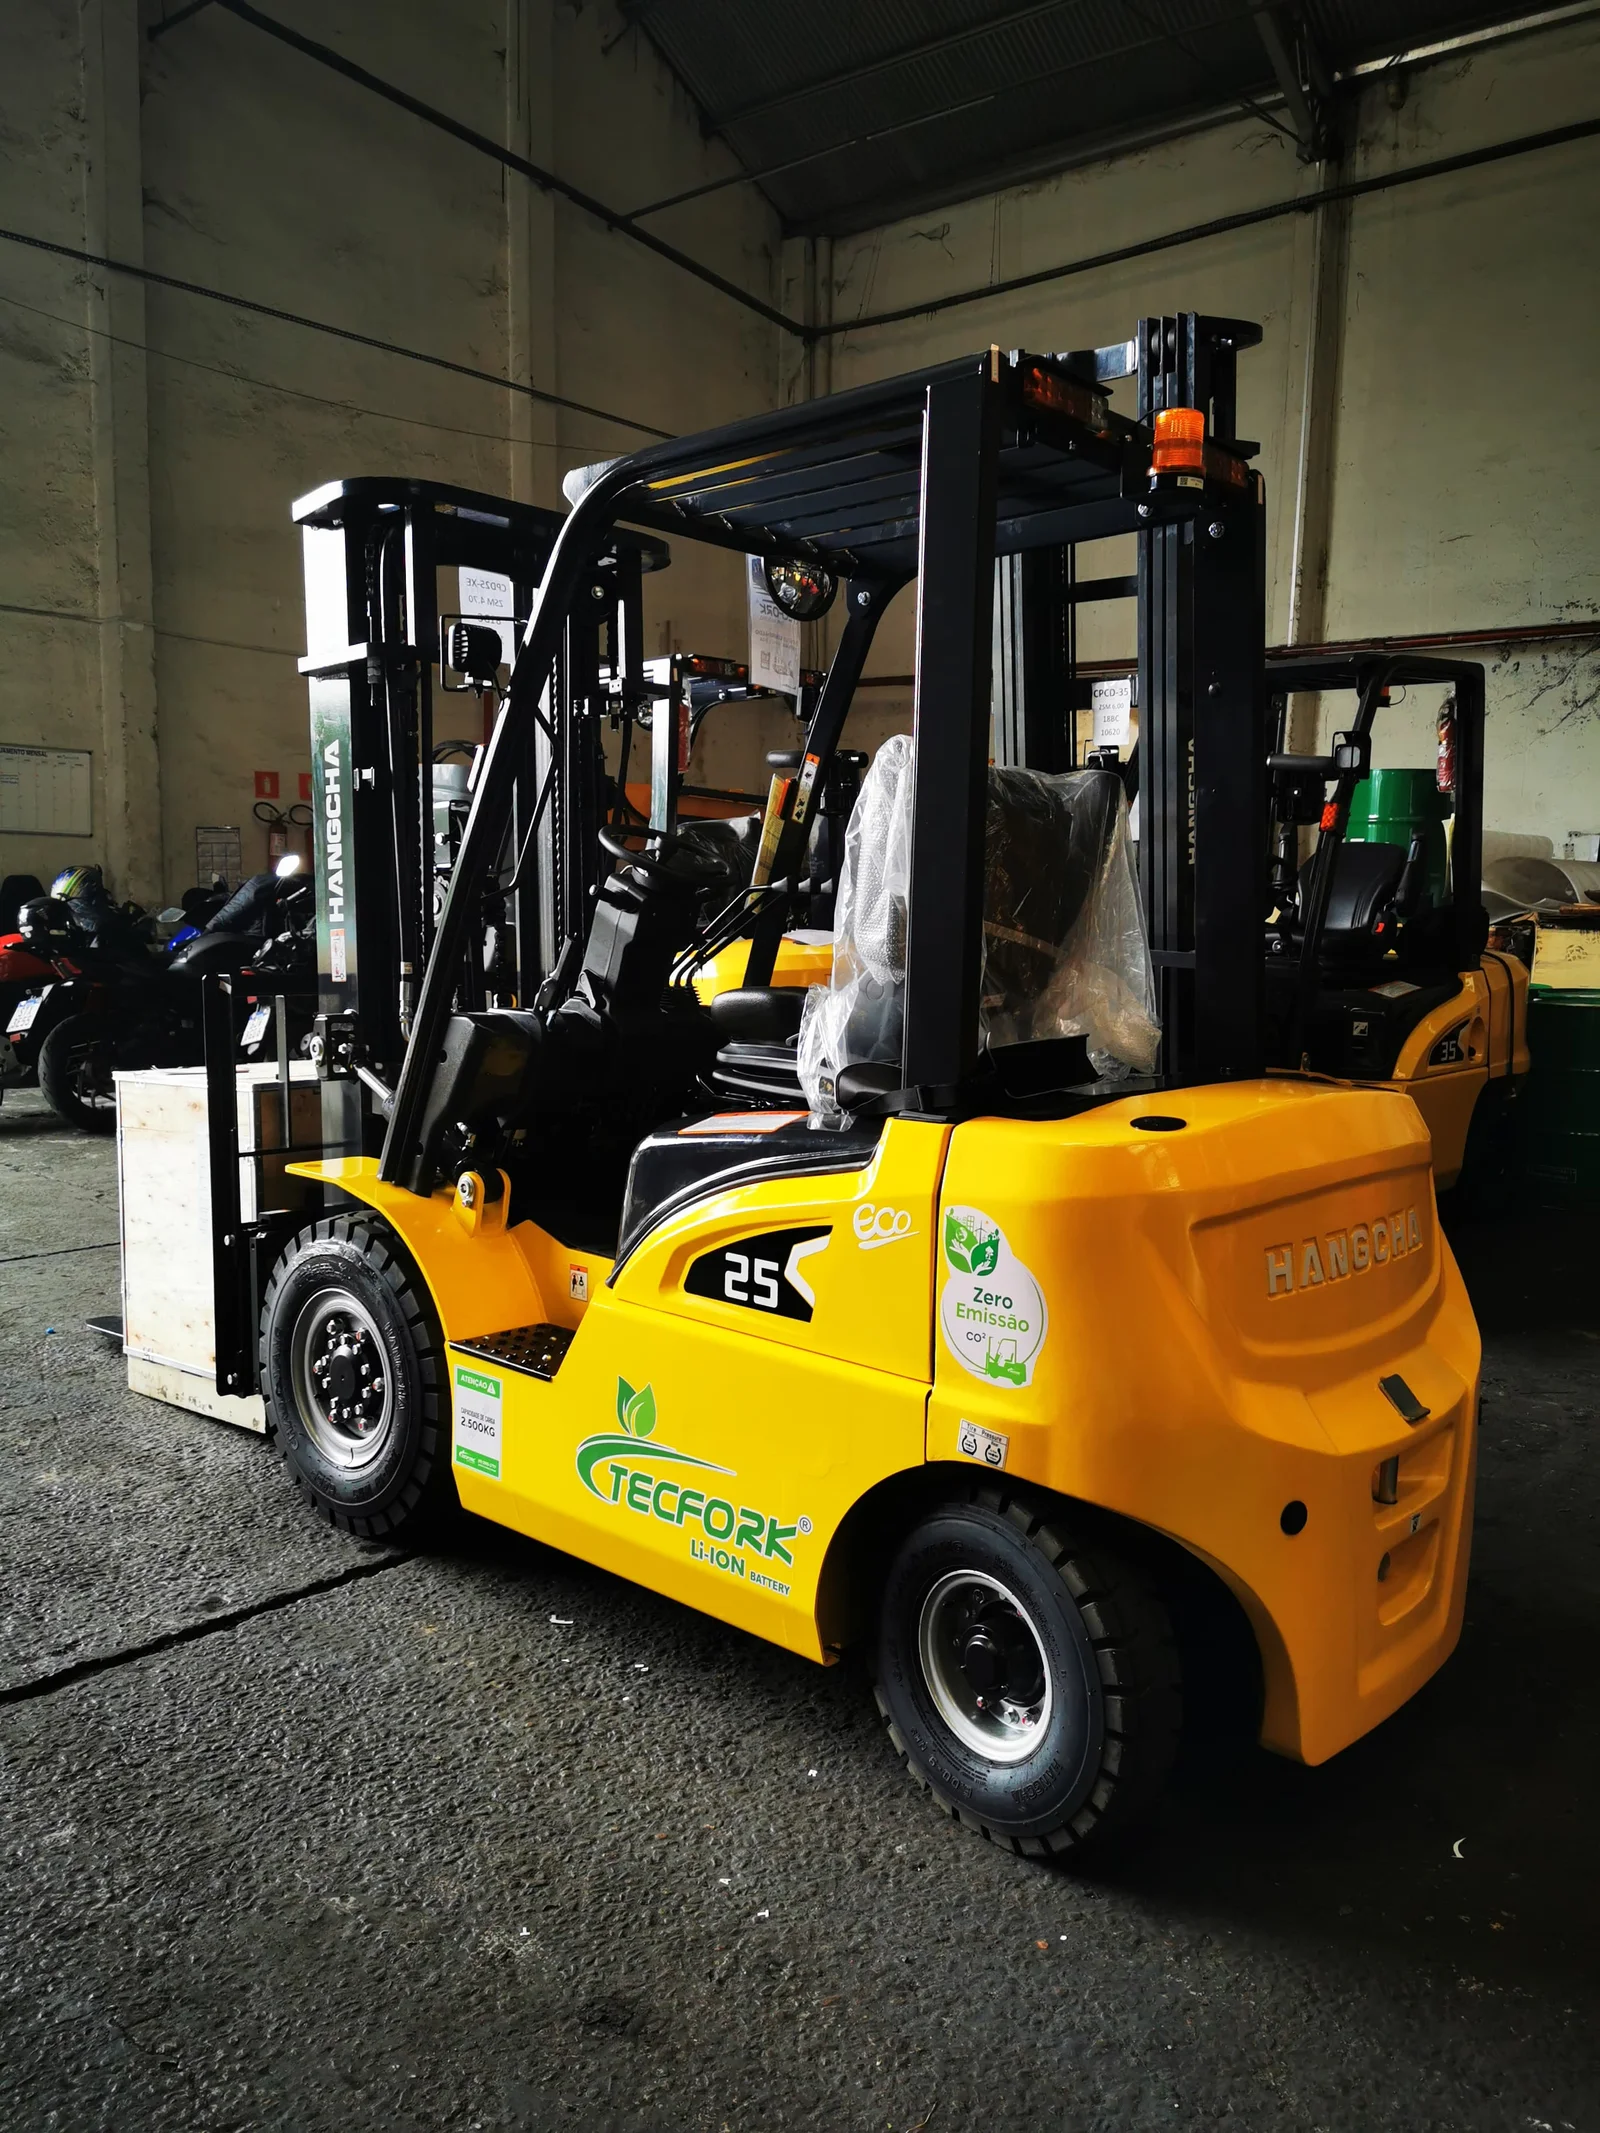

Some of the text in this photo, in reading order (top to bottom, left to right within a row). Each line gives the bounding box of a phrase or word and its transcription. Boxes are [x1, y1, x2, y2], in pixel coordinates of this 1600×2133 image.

[1093, 688, 1129, 698] CPCD-35
[1101, 728, 1120, 736] 10620
[324, 739, 344, 922] HANGCHA
[1440, 1040, 1457, 1061] 35
[1265, 1205, 1423, 1300] HANGCHA
[724, 1252, 779, 1309] 25
[973, 1287, 1013, 1310] Zero
[956, 1302, 1030, 1333] Emissão
[460, 1416, 496, 1437] 2.500KG
[689, 1538, 791, 1596] Li-ION BATTERY
[1011, 1759, 1064, 1803] HANGCHA
